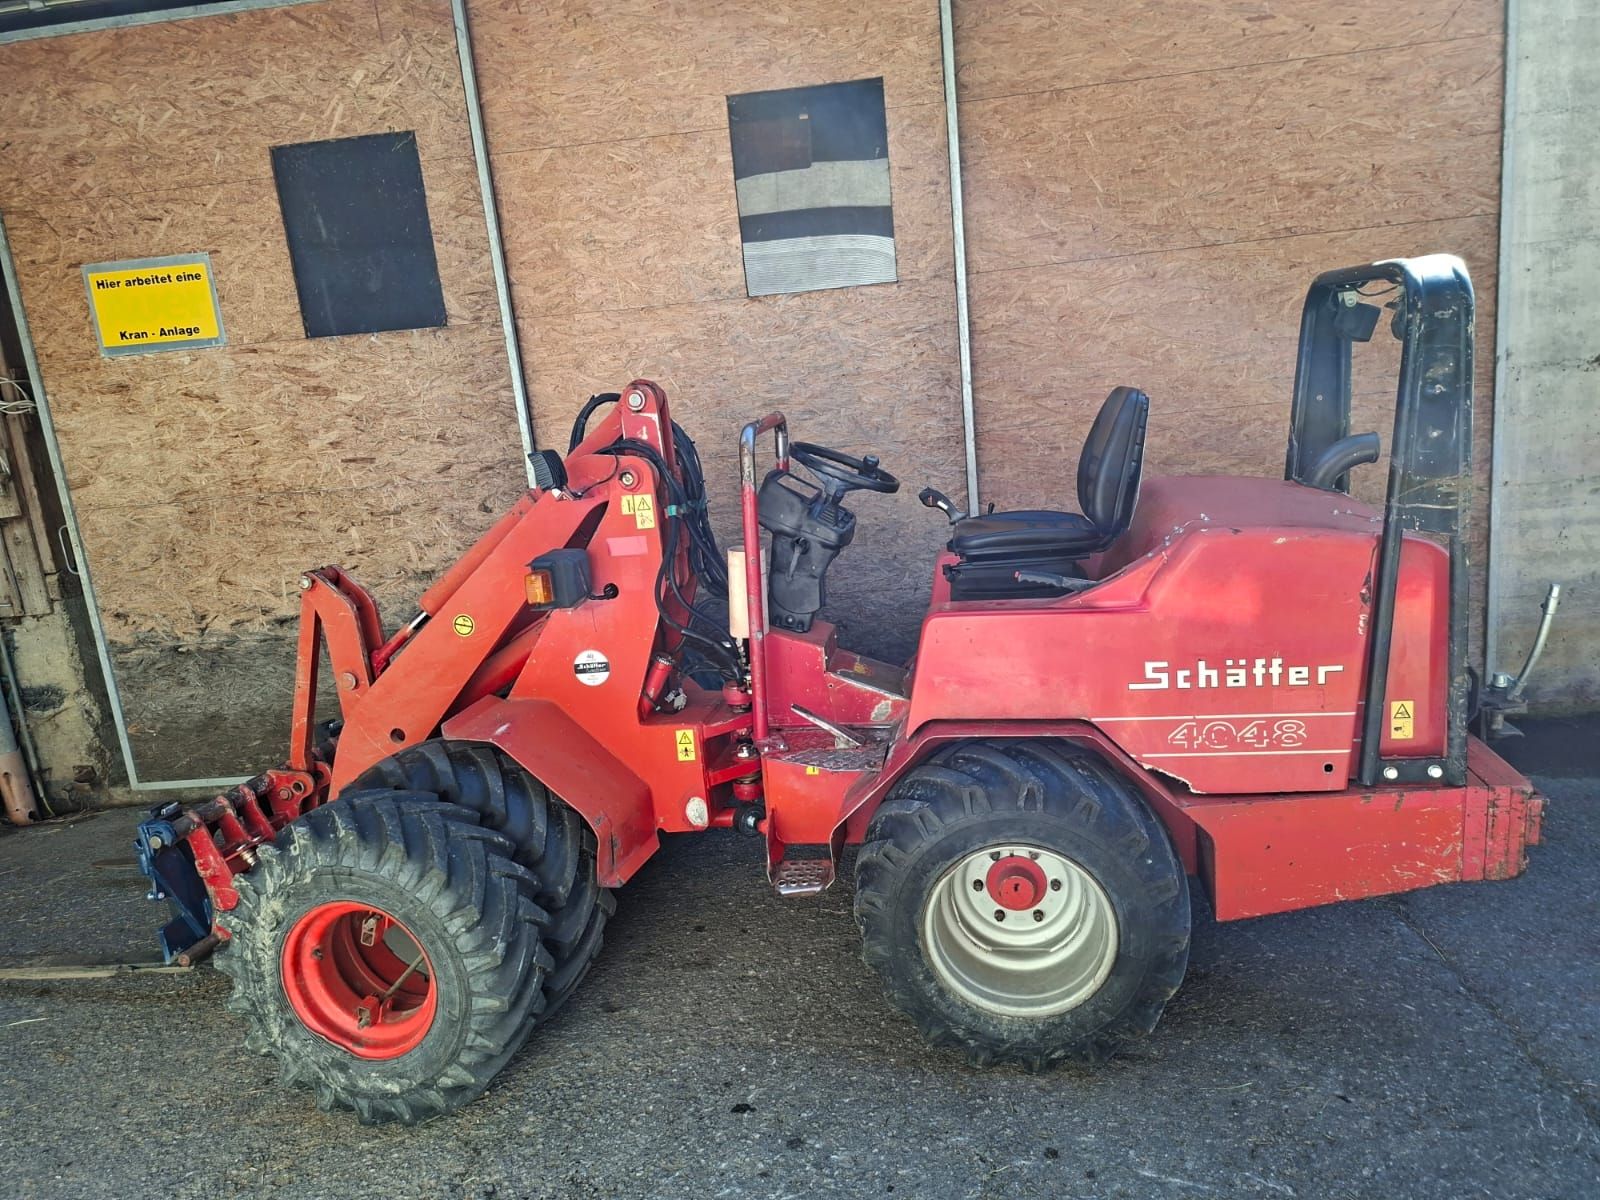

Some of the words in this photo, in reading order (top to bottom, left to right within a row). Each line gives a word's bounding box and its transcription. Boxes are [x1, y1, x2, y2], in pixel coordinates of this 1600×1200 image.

[96, 280, 121, 289] Hier
[125, 274, 172, 287] arbeitet
[175, 272, 201, 283] eine
[119, 330, 148, 340] Kran
[159, 326, 200, 337] Anlage
[1128, 658, 1344, 690] Schäffer
[1168, 719, 1307, 749] 4048
